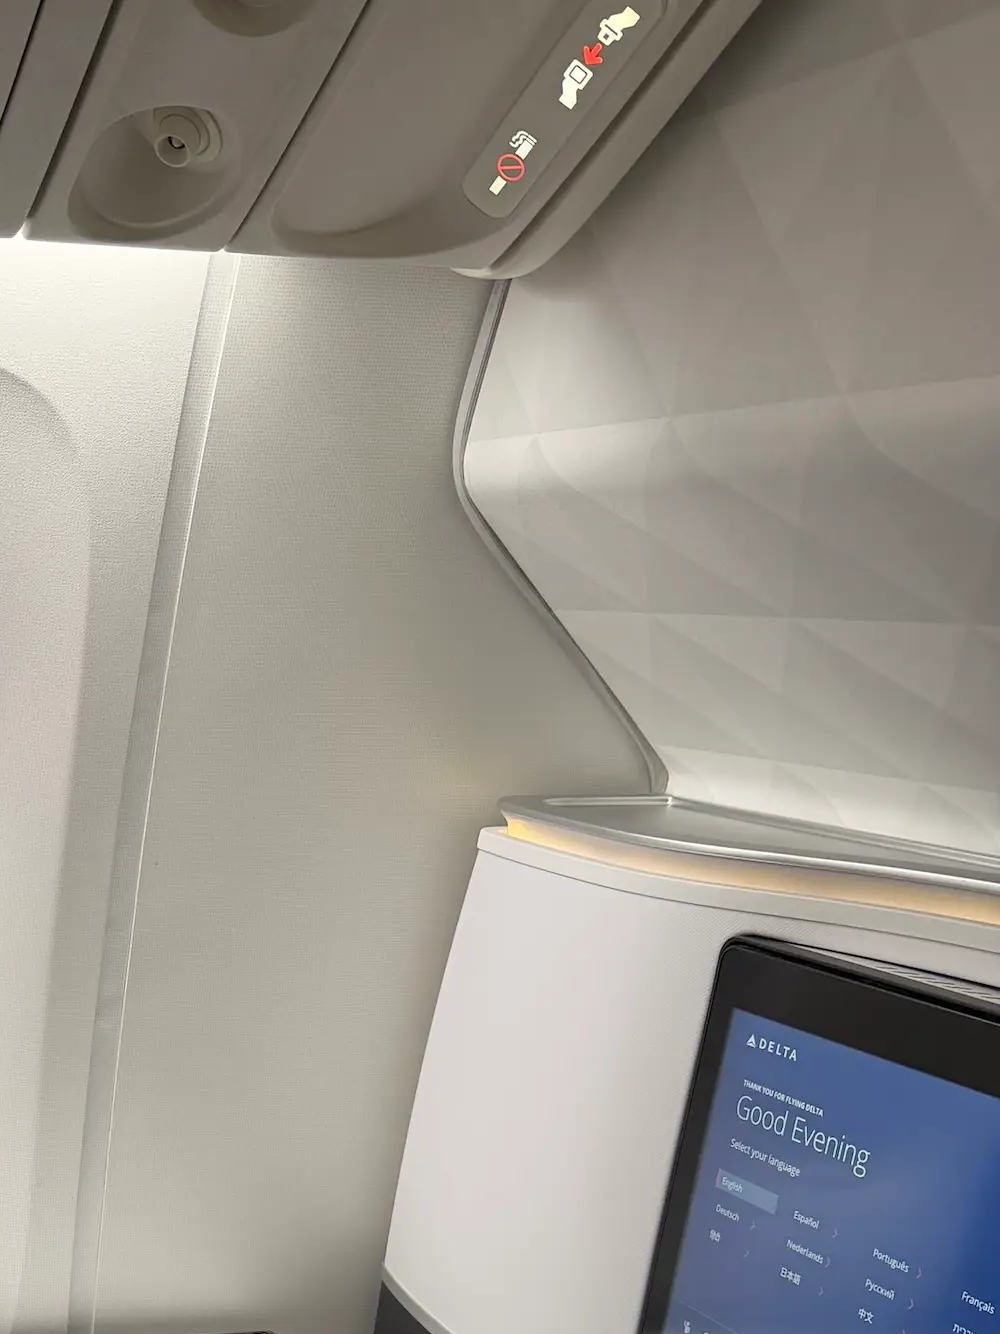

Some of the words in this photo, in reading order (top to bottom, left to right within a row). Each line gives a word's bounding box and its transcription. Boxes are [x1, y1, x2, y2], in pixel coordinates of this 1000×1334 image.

[758, 1038, 797, 1062] DELTA
[743, 1079, 762, 1093] THANK
[762, 1086, 774, 1097] YOU
[774, 1091, 785, 1102] FOR
[785, 1095, 805, 1110] FLYING
[805, 1103, 824, 1117] DELTA
[736, 1095, 789, 1137] Good
[791, 1116, 871, 1178] Evening
[730, 1138, 751, 1151] Select
[750, 1147, 767, 1162] your
[767, 1154, 800, 1177] language
[722, 1177, 743, 1194] English
[715, 1204, 740, 1221] Deutsch
[793, 1210, 820, 1229] Español
[786, 1239, 824, 1264] Nederlands
[872, 1248, 910, 1273] Português
[780, 1267, 801, 1285] 日本語
[865, 1278, 895, 1300] Русский
[961, 1291, 995, 1315] Français
[858, 1307, 874, 1324] 中文
